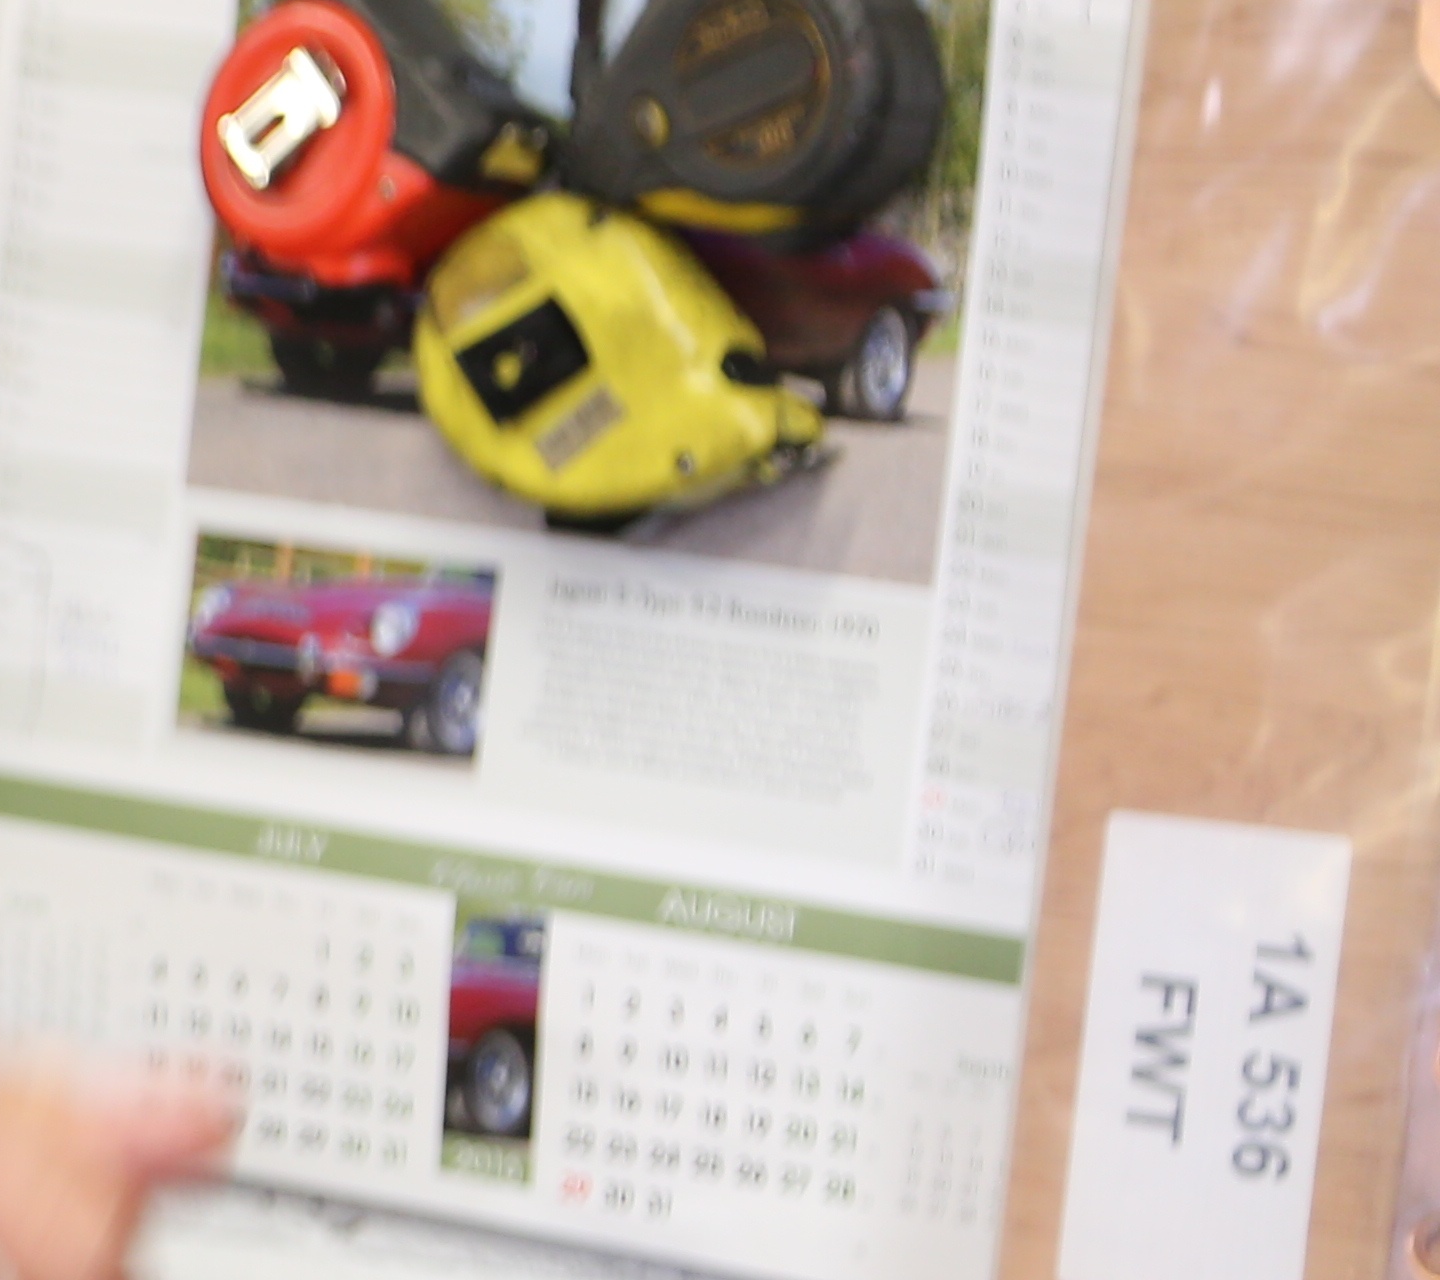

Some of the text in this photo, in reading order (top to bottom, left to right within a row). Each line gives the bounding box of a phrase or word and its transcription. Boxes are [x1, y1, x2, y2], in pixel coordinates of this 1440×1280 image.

[1126, 974, 1198, 1144] FWT
[1231, 931, 1315, 1183] 1A 536
